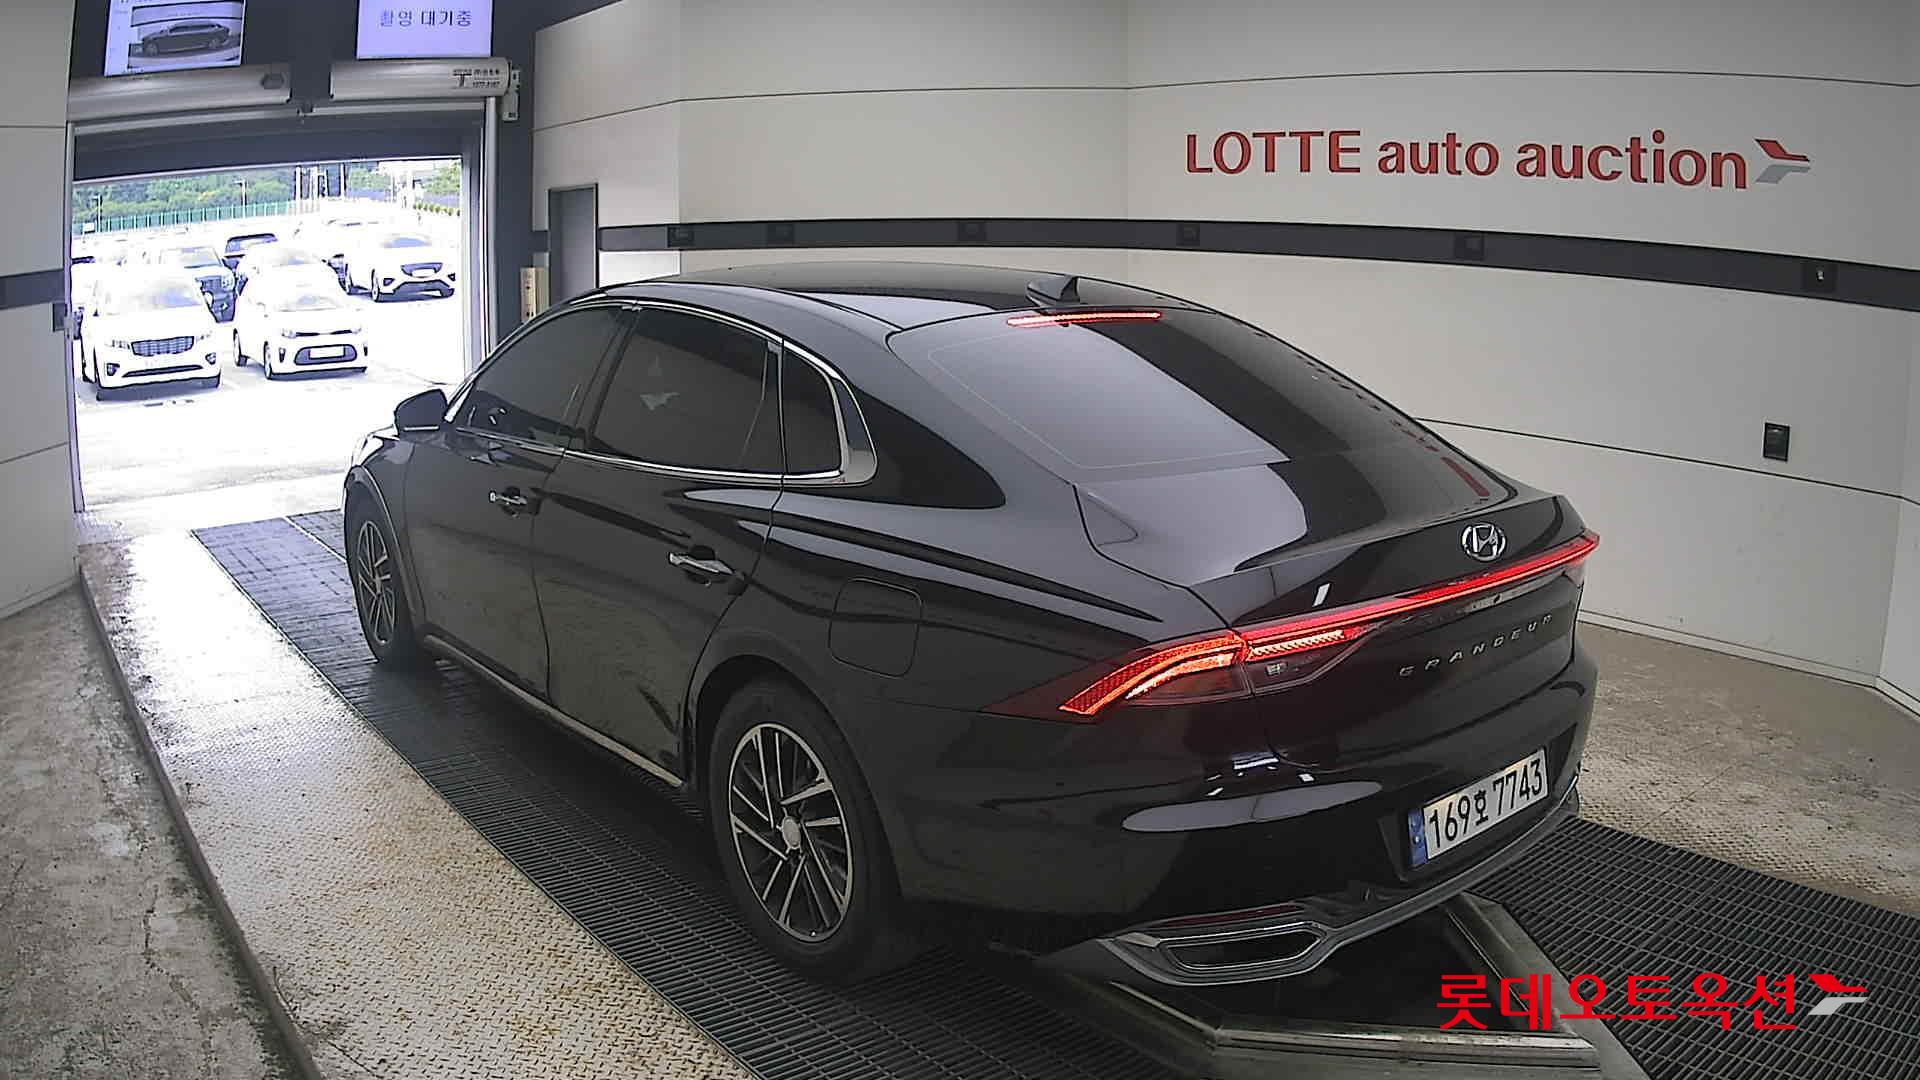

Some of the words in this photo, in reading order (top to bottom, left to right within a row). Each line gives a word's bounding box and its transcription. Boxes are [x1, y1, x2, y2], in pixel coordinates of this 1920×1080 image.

[421, 10, 471, 27] 대기중
[1186, 130, 1361, 174] LOTTE
[1378, 133, 1500, 176] auto
[1515, 130, 1747, 188] auction
[1399, 614, 1552, 677] GRANDEUR
[1429, 790, 1489, 849] 169호
[1492, 758, 1543, 817] 7743
